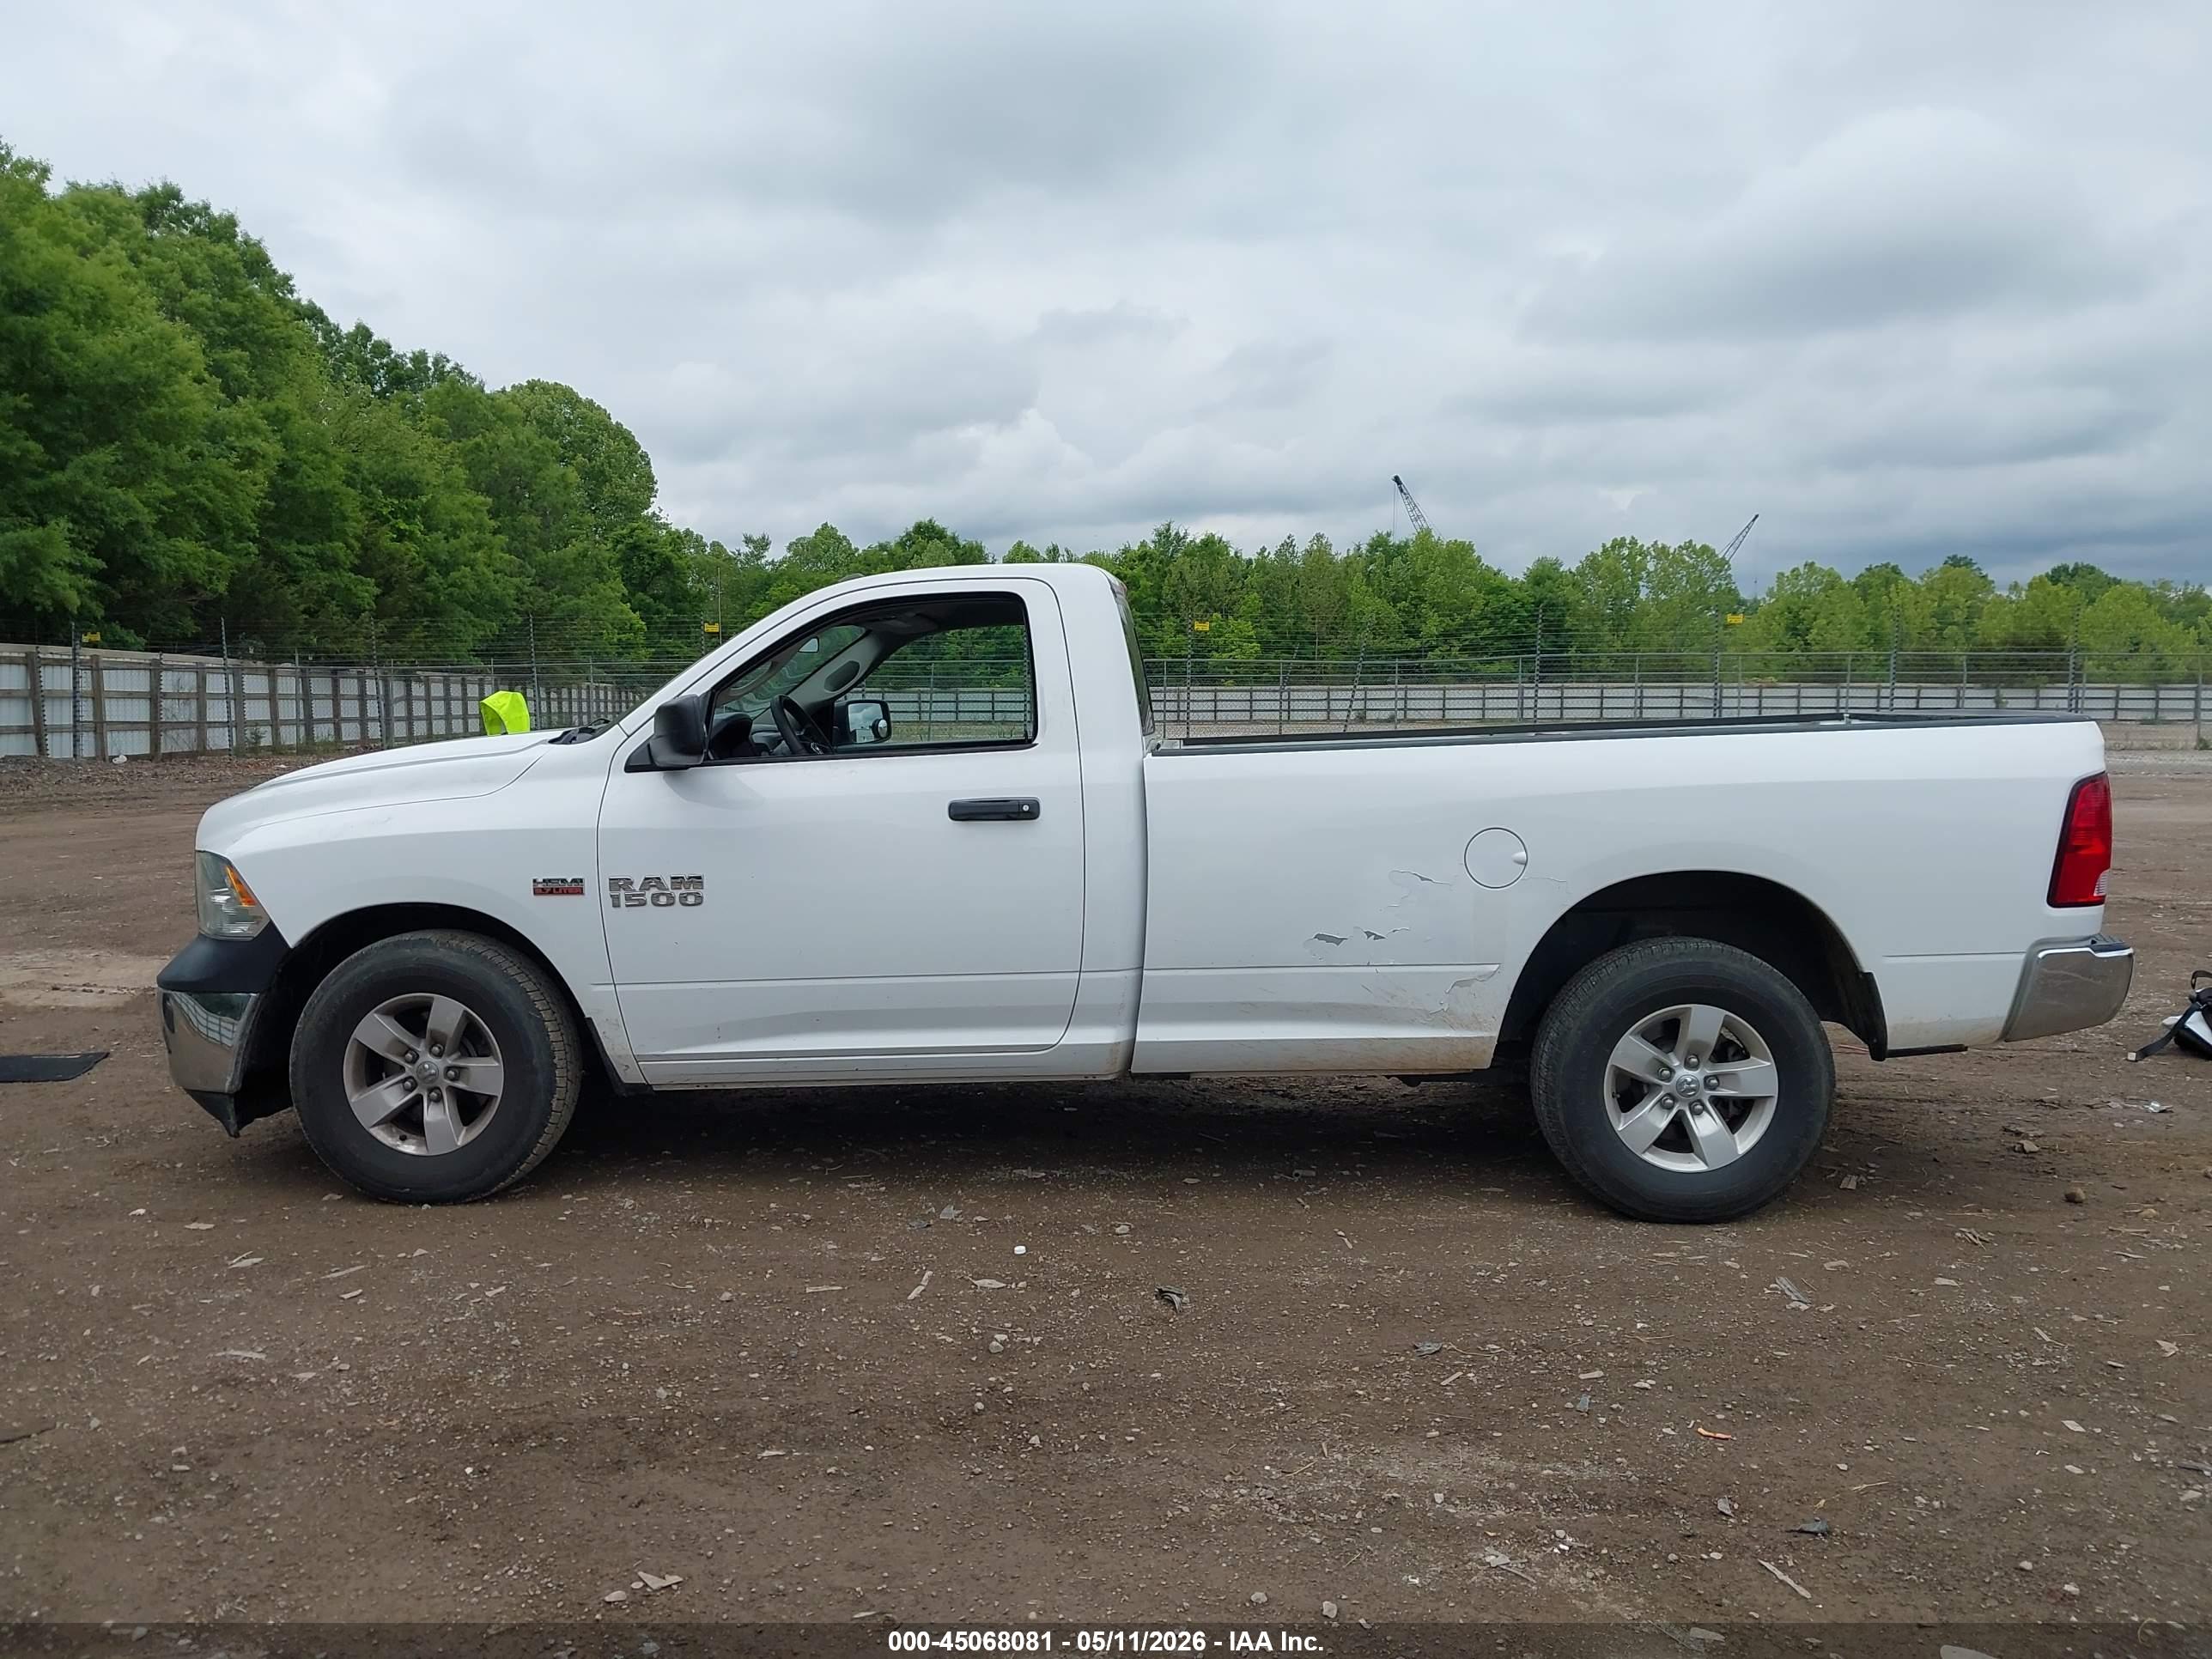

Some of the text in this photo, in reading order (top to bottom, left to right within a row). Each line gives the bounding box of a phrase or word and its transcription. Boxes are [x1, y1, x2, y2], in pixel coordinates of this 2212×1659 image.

[532, 878, 584, 886] HEMI
[608, 874, 704, 891] RAM
[609, 891, 704, 908] 1500
